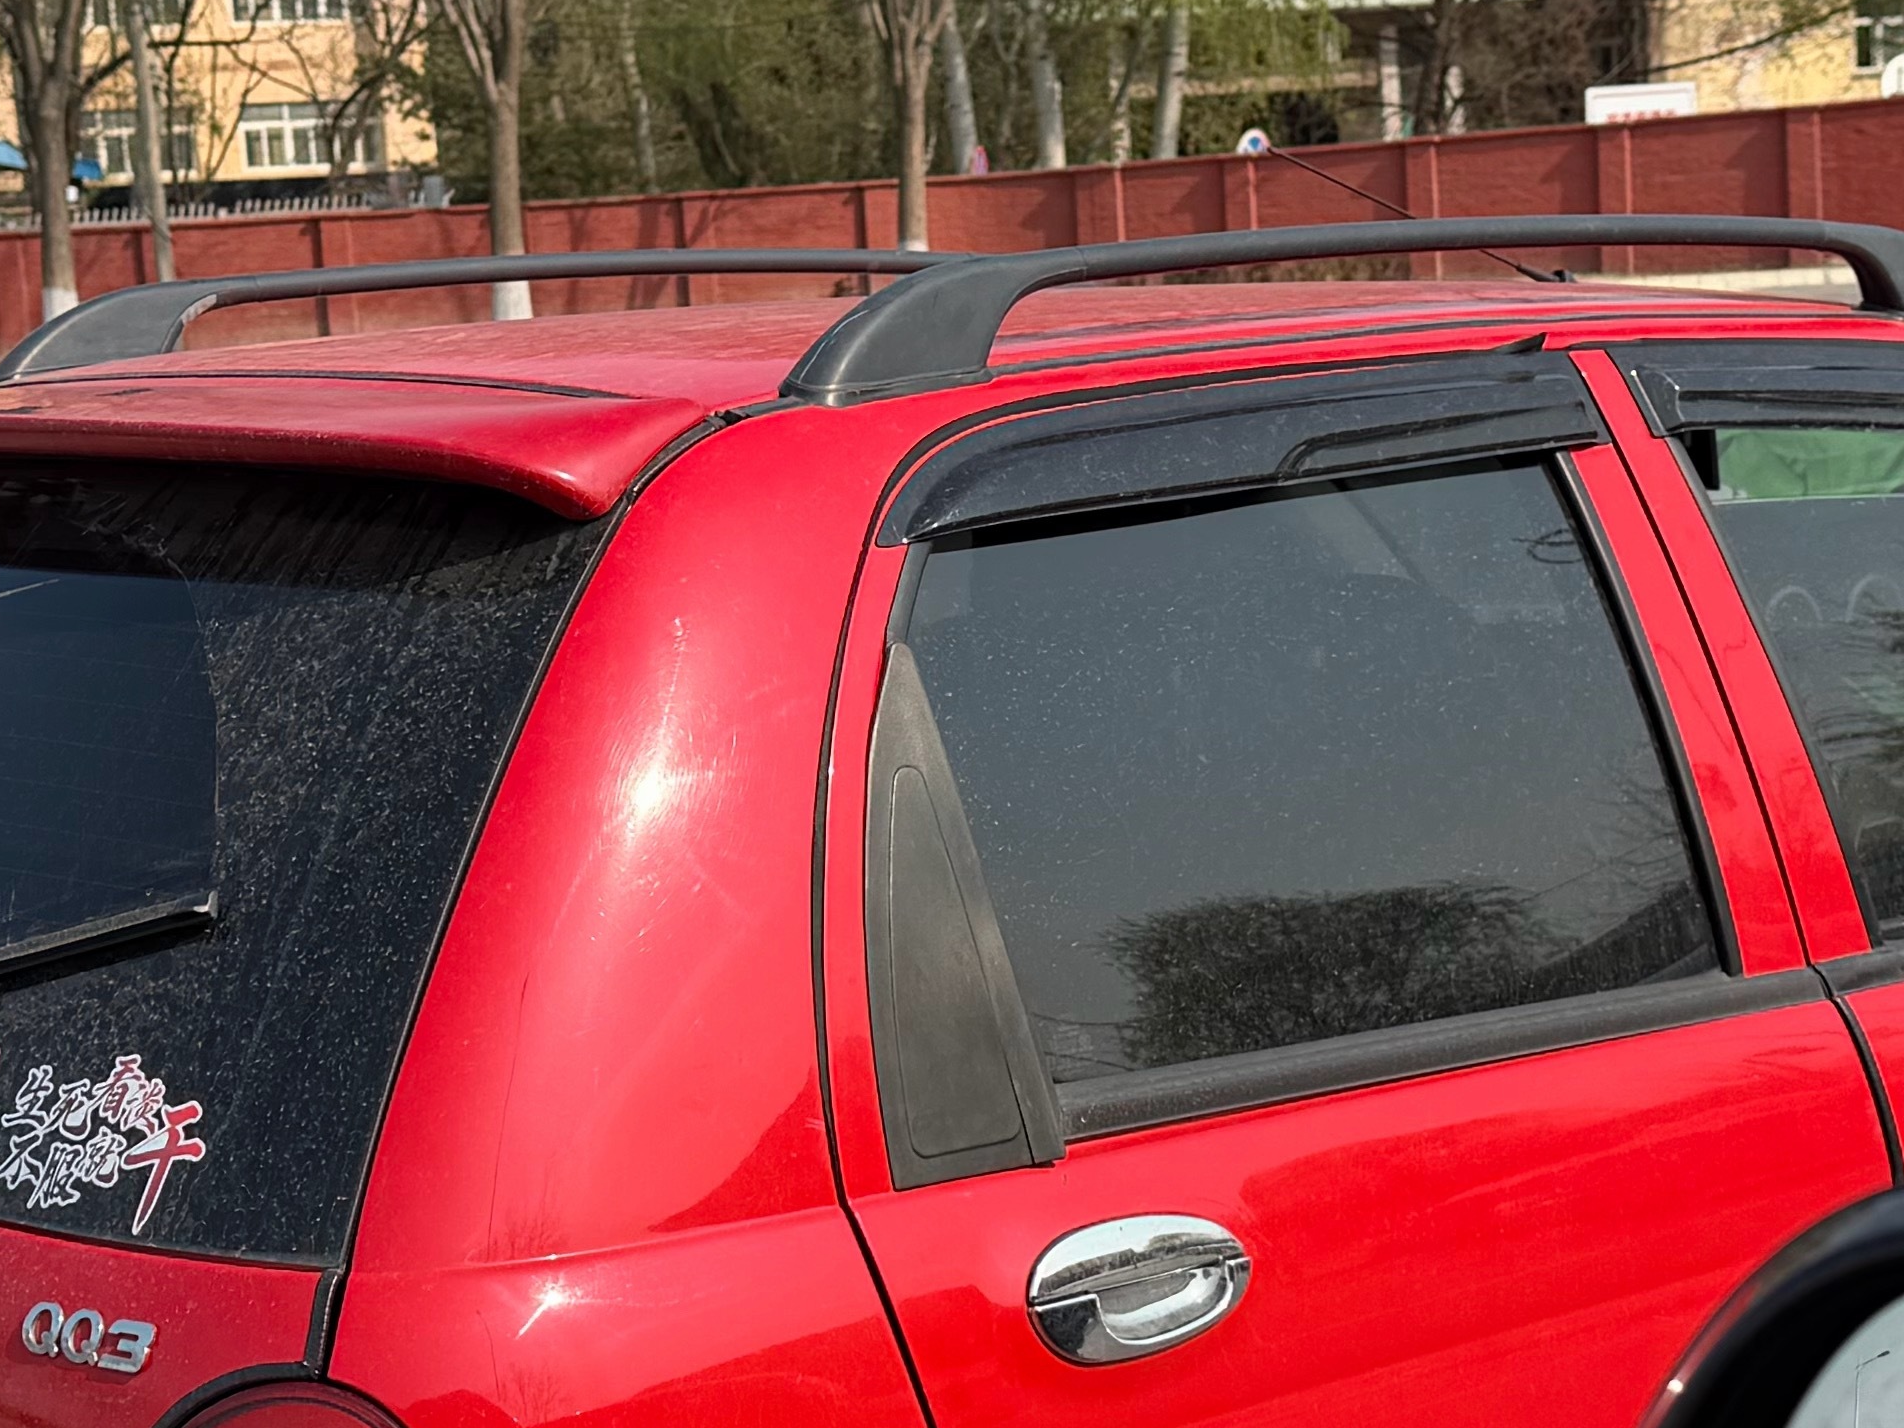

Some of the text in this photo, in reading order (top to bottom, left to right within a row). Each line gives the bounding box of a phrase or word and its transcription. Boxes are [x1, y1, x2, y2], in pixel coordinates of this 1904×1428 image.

[2, 1054, 166, 1140] 生死看淡
[22, 1301, 157, 1373] QQ3
